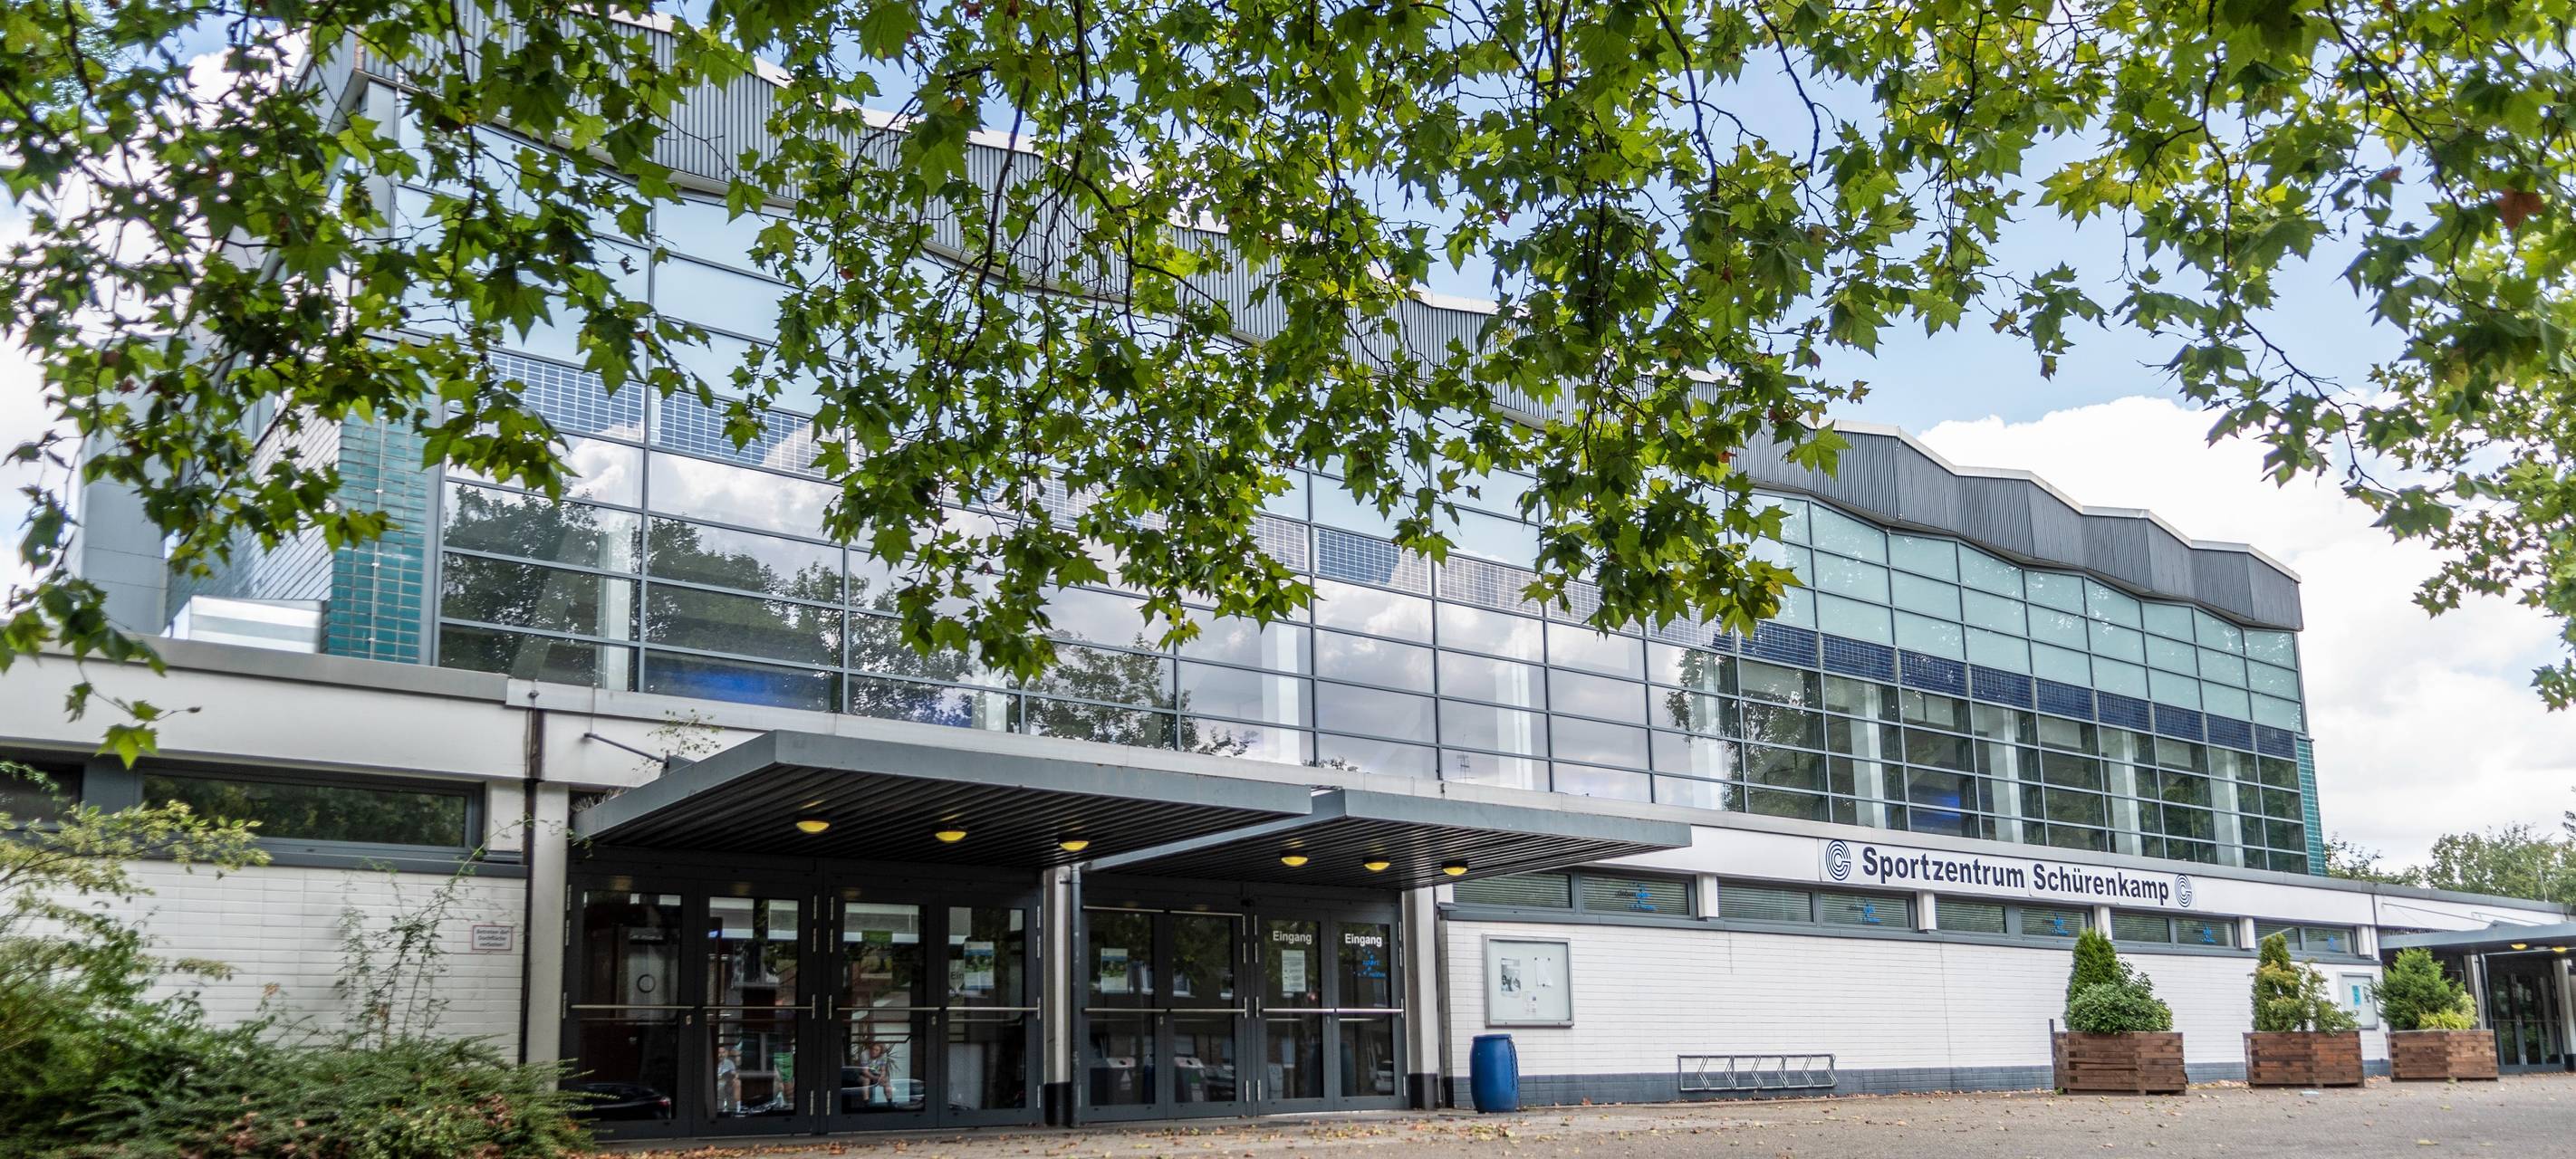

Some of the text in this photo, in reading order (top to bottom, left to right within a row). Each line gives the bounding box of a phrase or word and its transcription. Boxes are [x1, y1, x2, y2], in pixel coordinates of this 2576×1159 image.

[1862, 846, 2169, 905] Sportzentrum Schürenkamp
[1273, 930, 1312, 944] Eingang
[1344, 933, 1383, 948] Eingang
